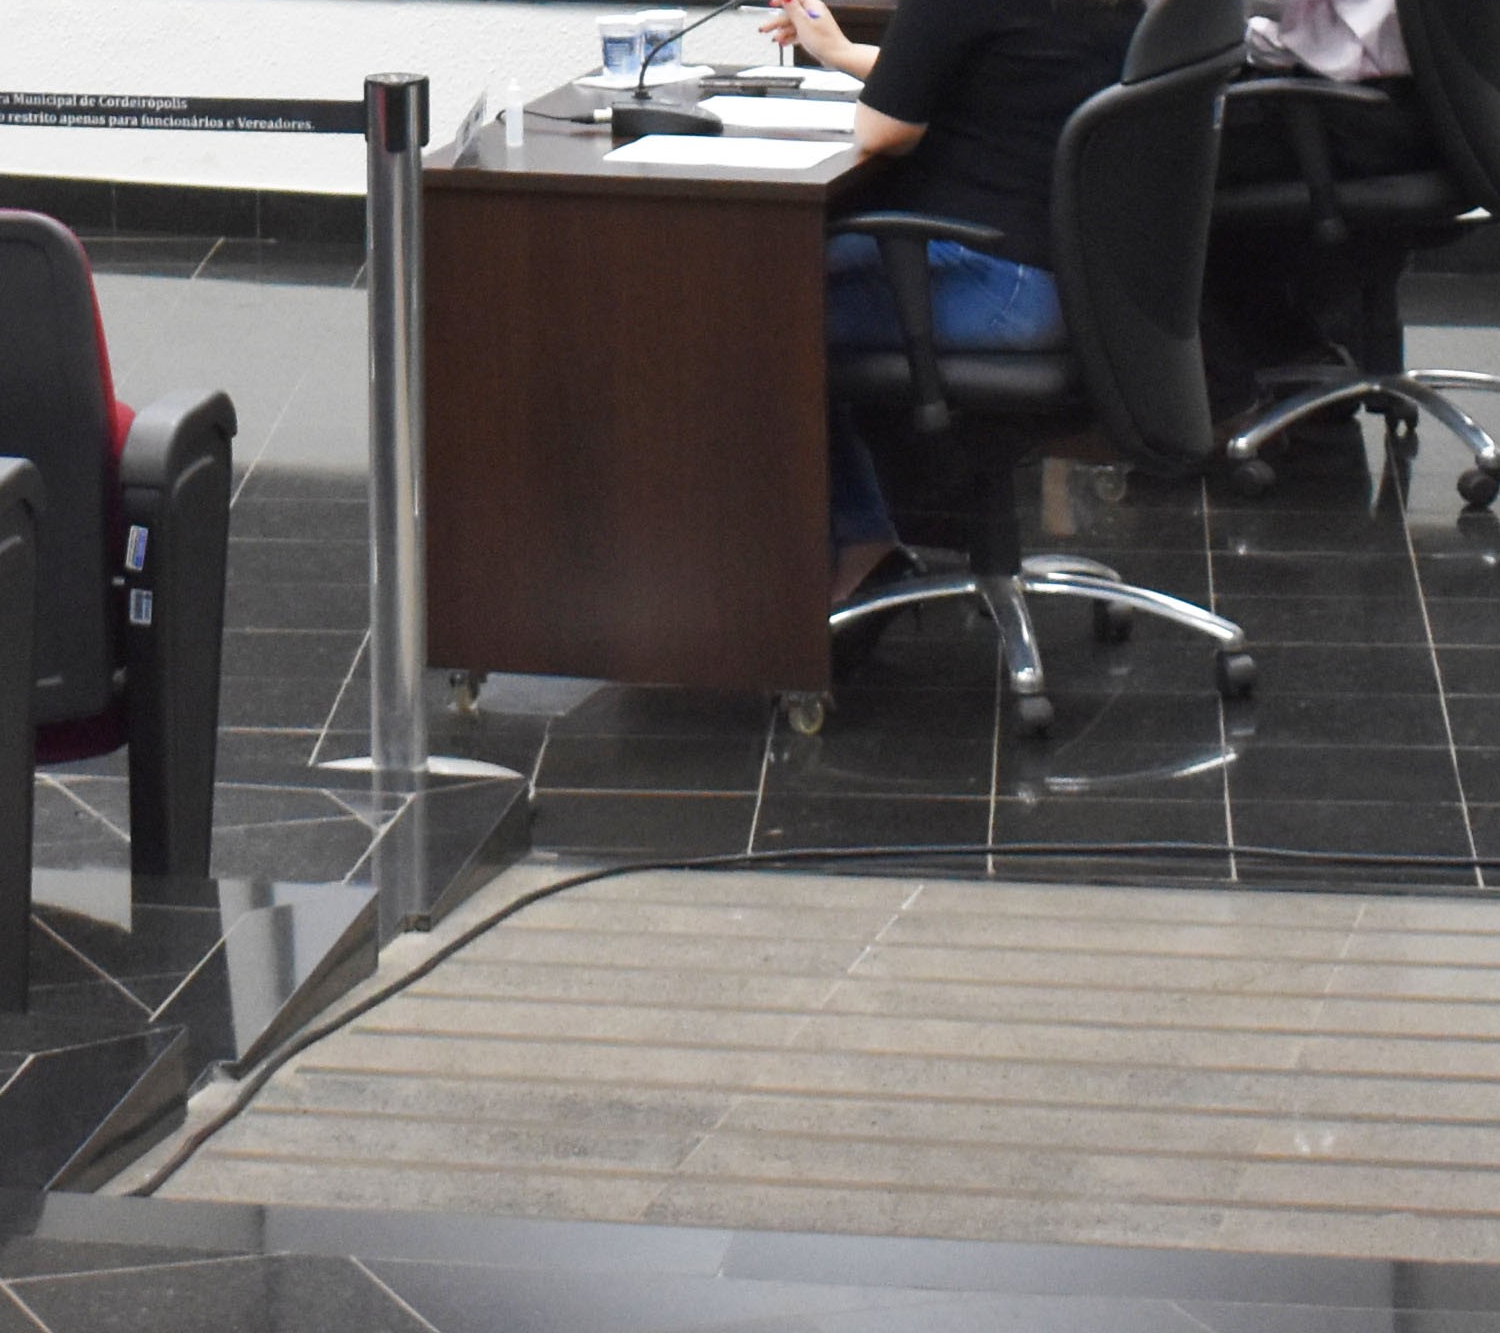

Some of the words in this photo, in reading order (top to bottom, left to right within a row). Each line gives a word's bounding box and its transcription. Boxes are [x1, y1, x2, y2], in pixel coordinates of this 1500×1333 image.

[13, 93, 77, 108] Municipal
[80, 94, 95, 106] de
[98, 95, 188, 111] Cordeirópolis
[7, 112, 57, 124] restrito
[59, 114, 106, 126] apenas
[108, 116, 138, 128] para
[141, 115, 223, 129] funcionários
[226, 119, 234, 128] e
